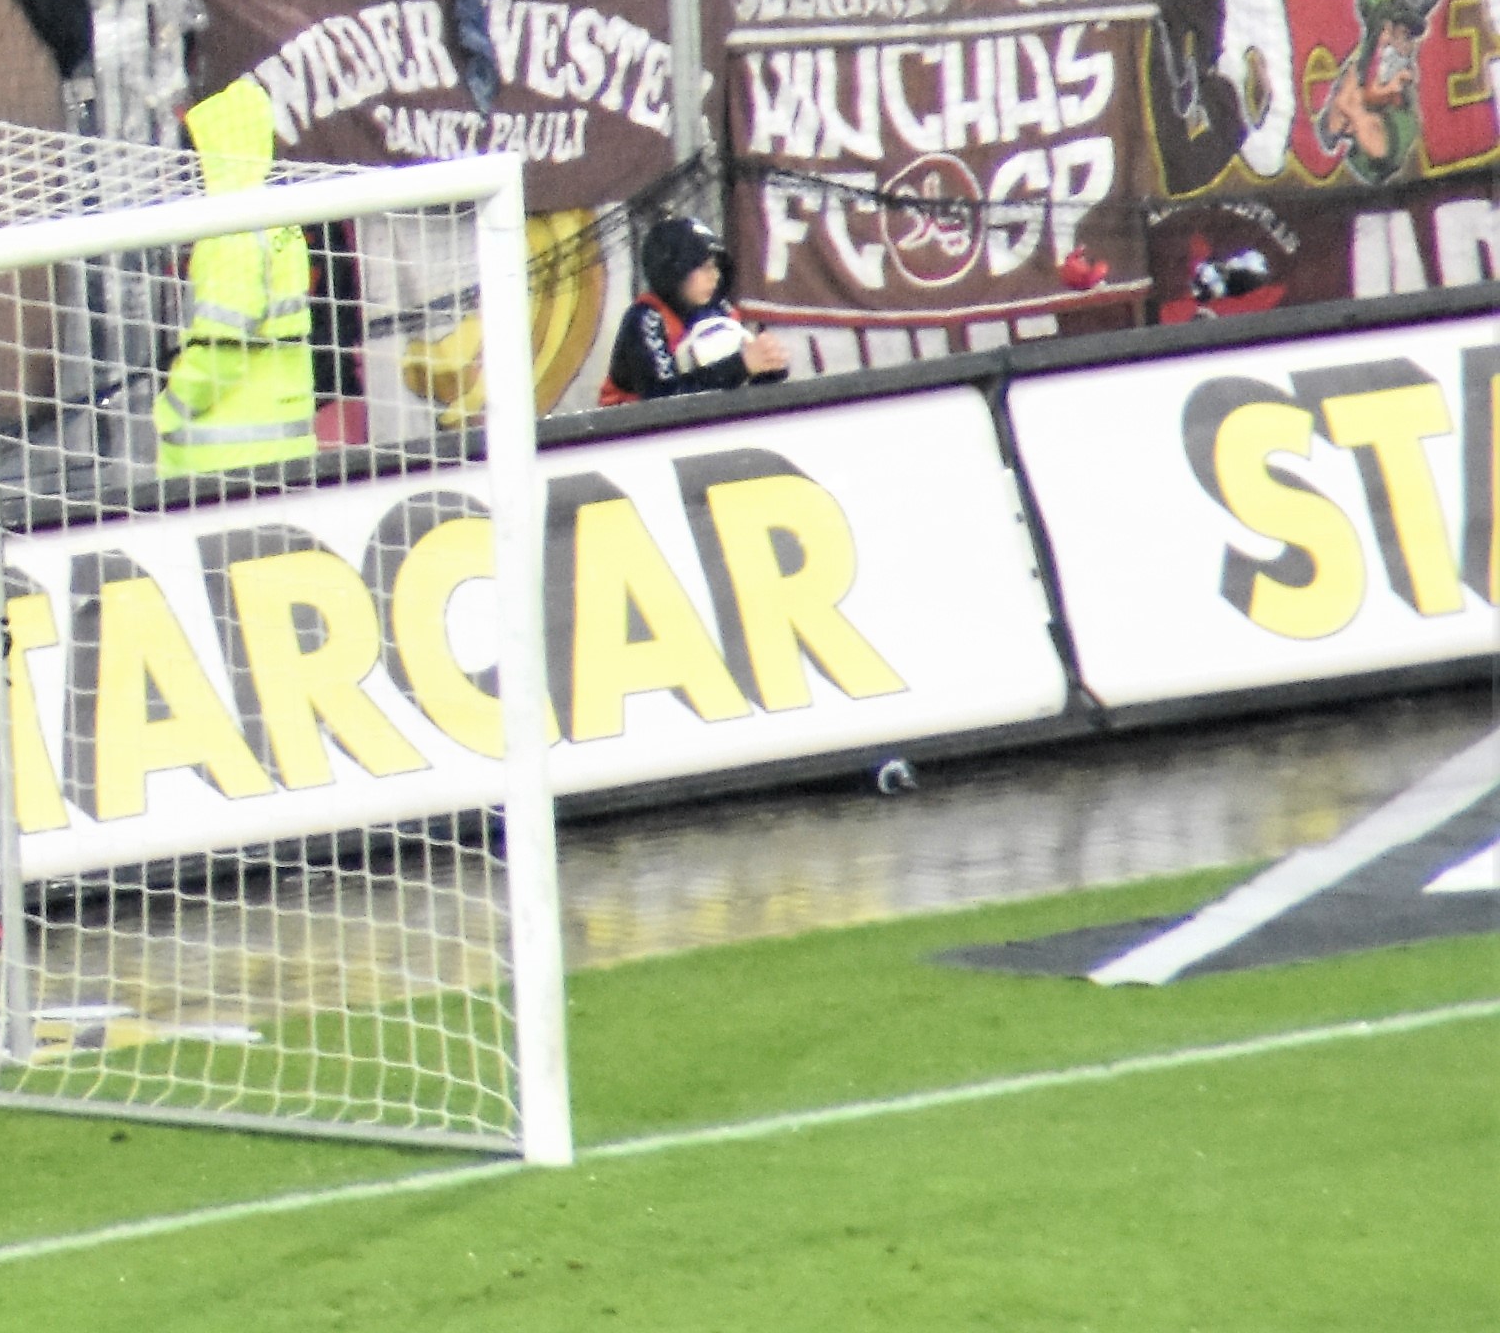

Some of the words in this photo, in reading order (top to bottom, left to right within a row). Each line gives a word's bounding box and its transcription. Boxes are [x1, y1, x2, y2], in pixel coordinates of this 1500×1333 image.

[374, 104, 486, 161] SANKT
[488, 109, 589, 163] PAULI
[763, 171, 886, 290] FC
[985, 135, 1117, 277] SP
[1183, 345, 1500, 642] ST
